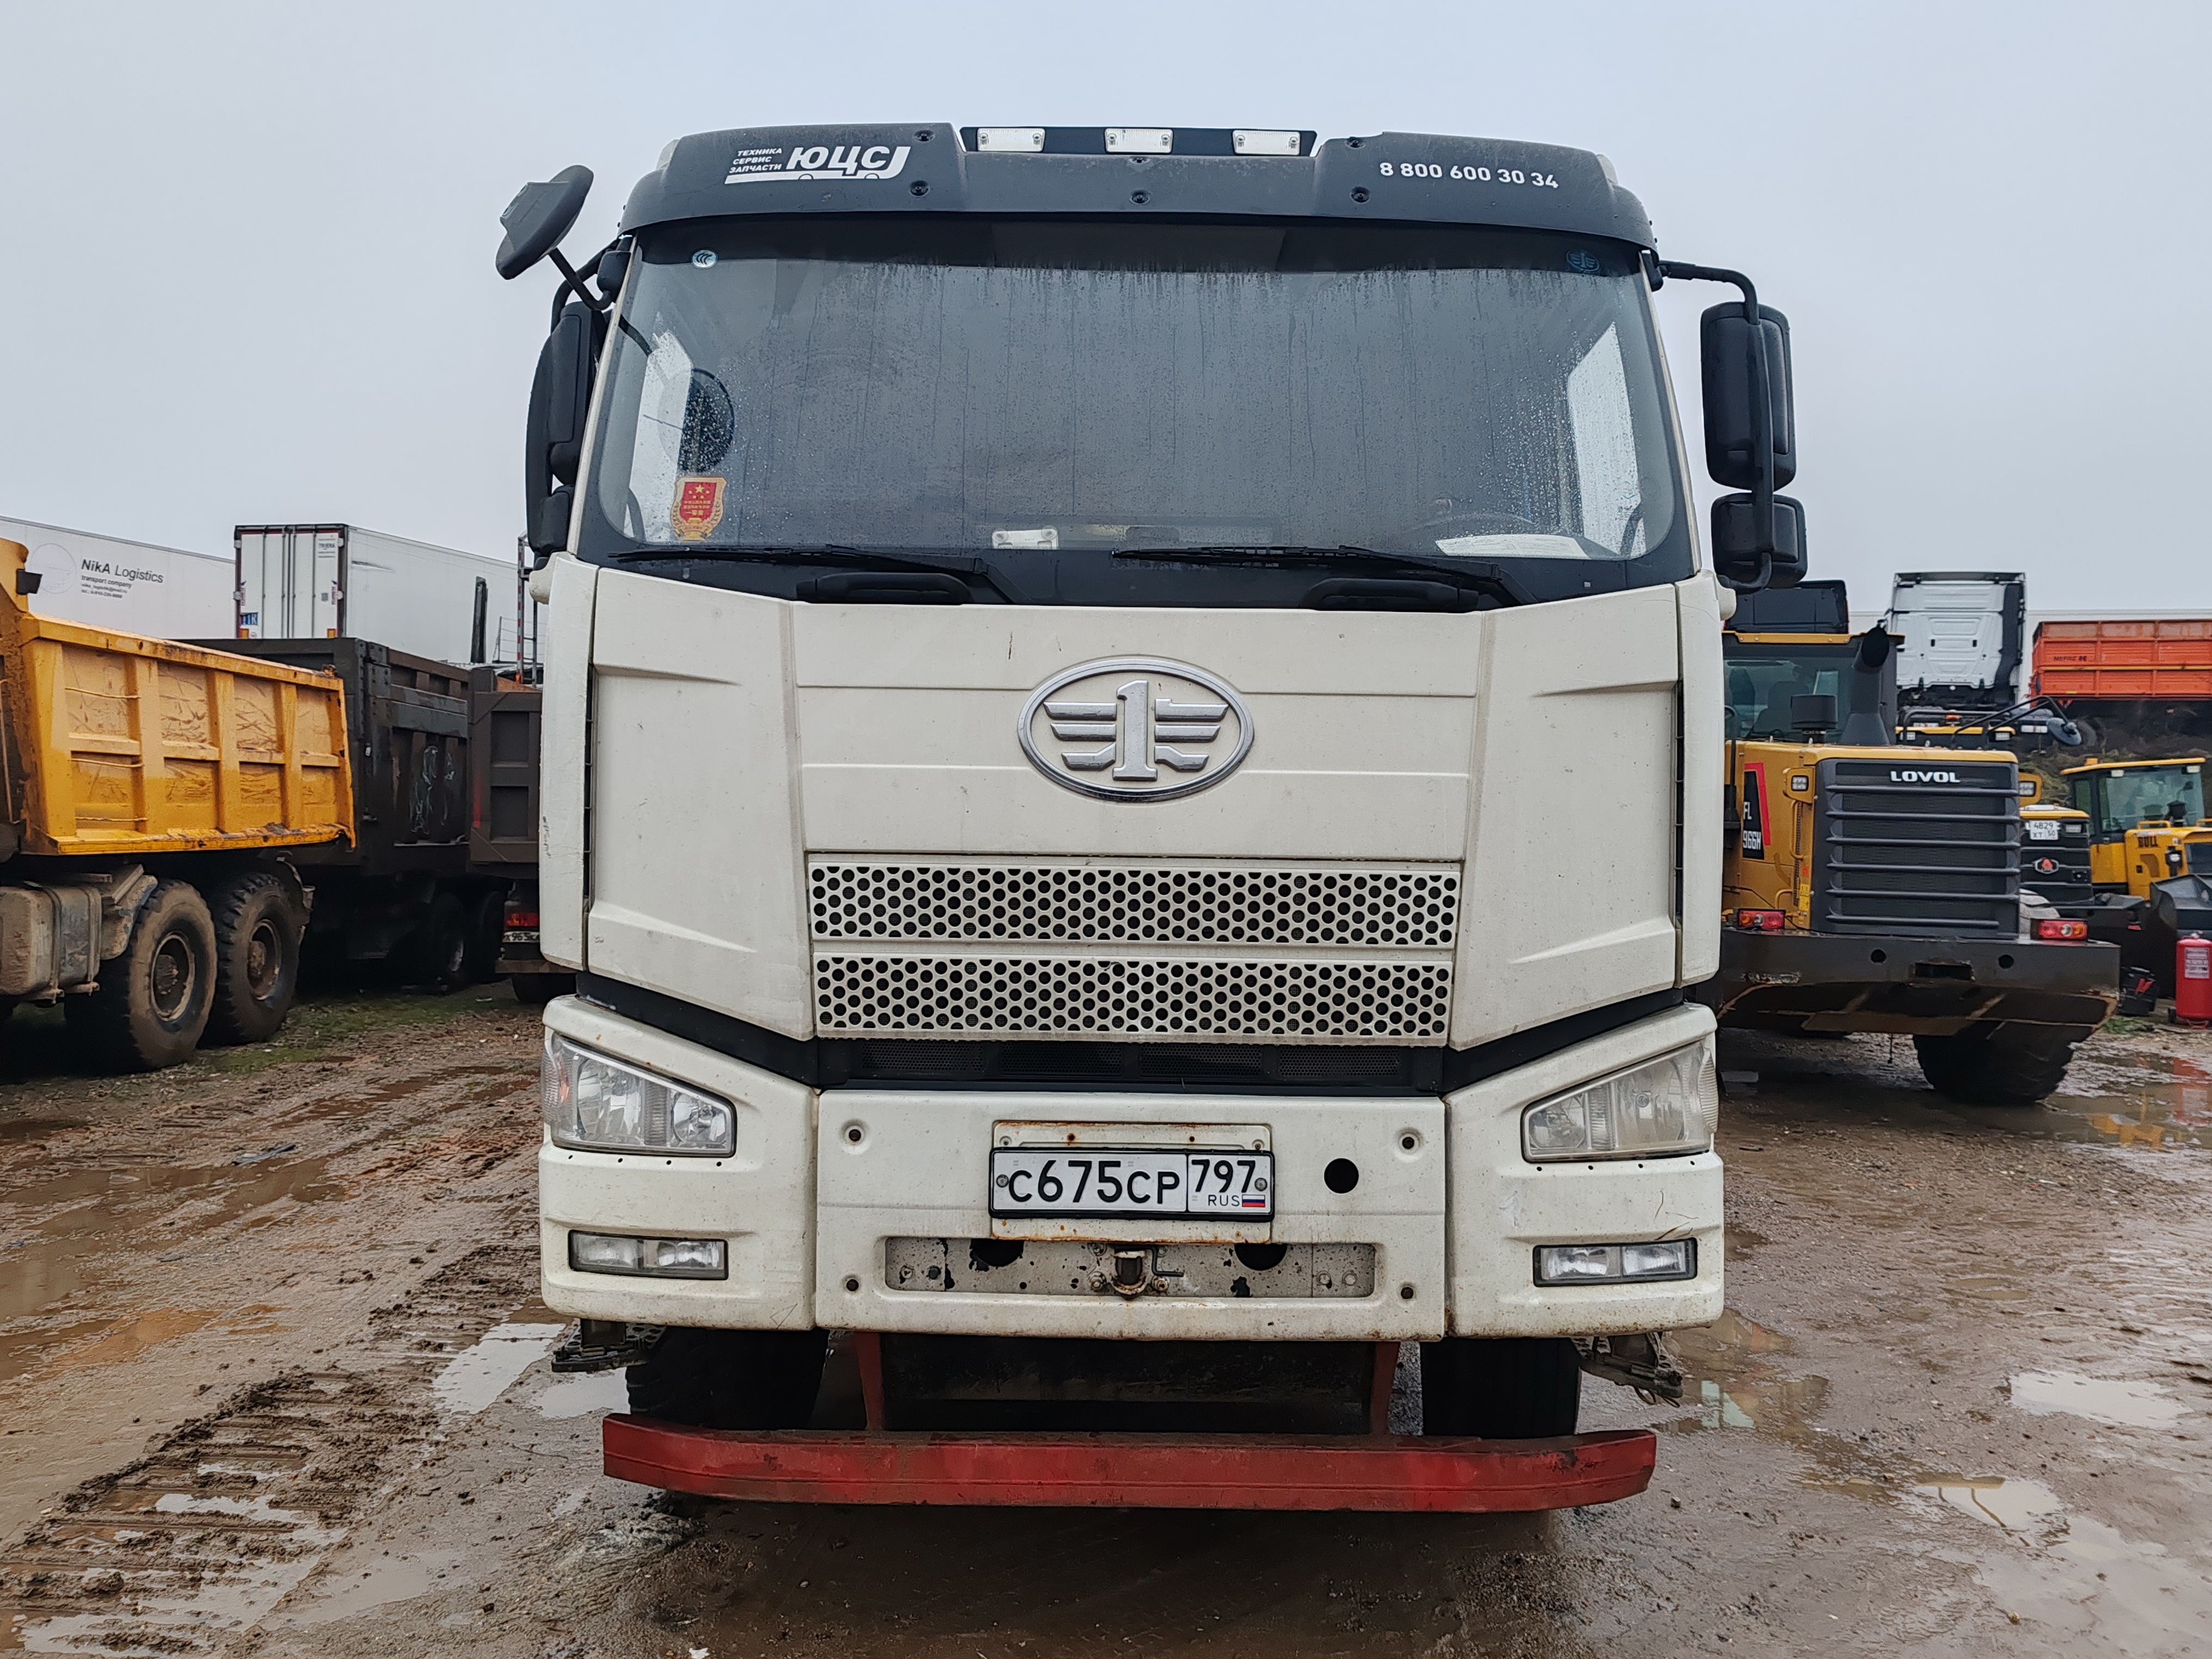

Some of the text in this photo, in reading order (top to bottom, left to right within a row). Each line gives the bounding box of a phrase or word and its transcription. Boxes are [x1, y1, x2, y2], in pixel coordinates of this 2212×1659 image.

[738, 148, 782, 157] ТЕХНИКА
[733, 156, 772, 165] СЕРВИС
[729, 163, 782, 174] ЗАПЧАСТИ
[1380, 162, 1559, 188] 8 800 600 30 34
[81, 559, 164, 583] NikA Logistics
[81, 575, 132, 589] transport company
[1890, 771, 1961, 783] LOVOL
[1743, 801, 1752, 820] FL
[1743, 831, 1761, 850] 966H
[1191, 1159, 1256, 1193] 797
[1208, 1194, 1240, 1207] RUS
